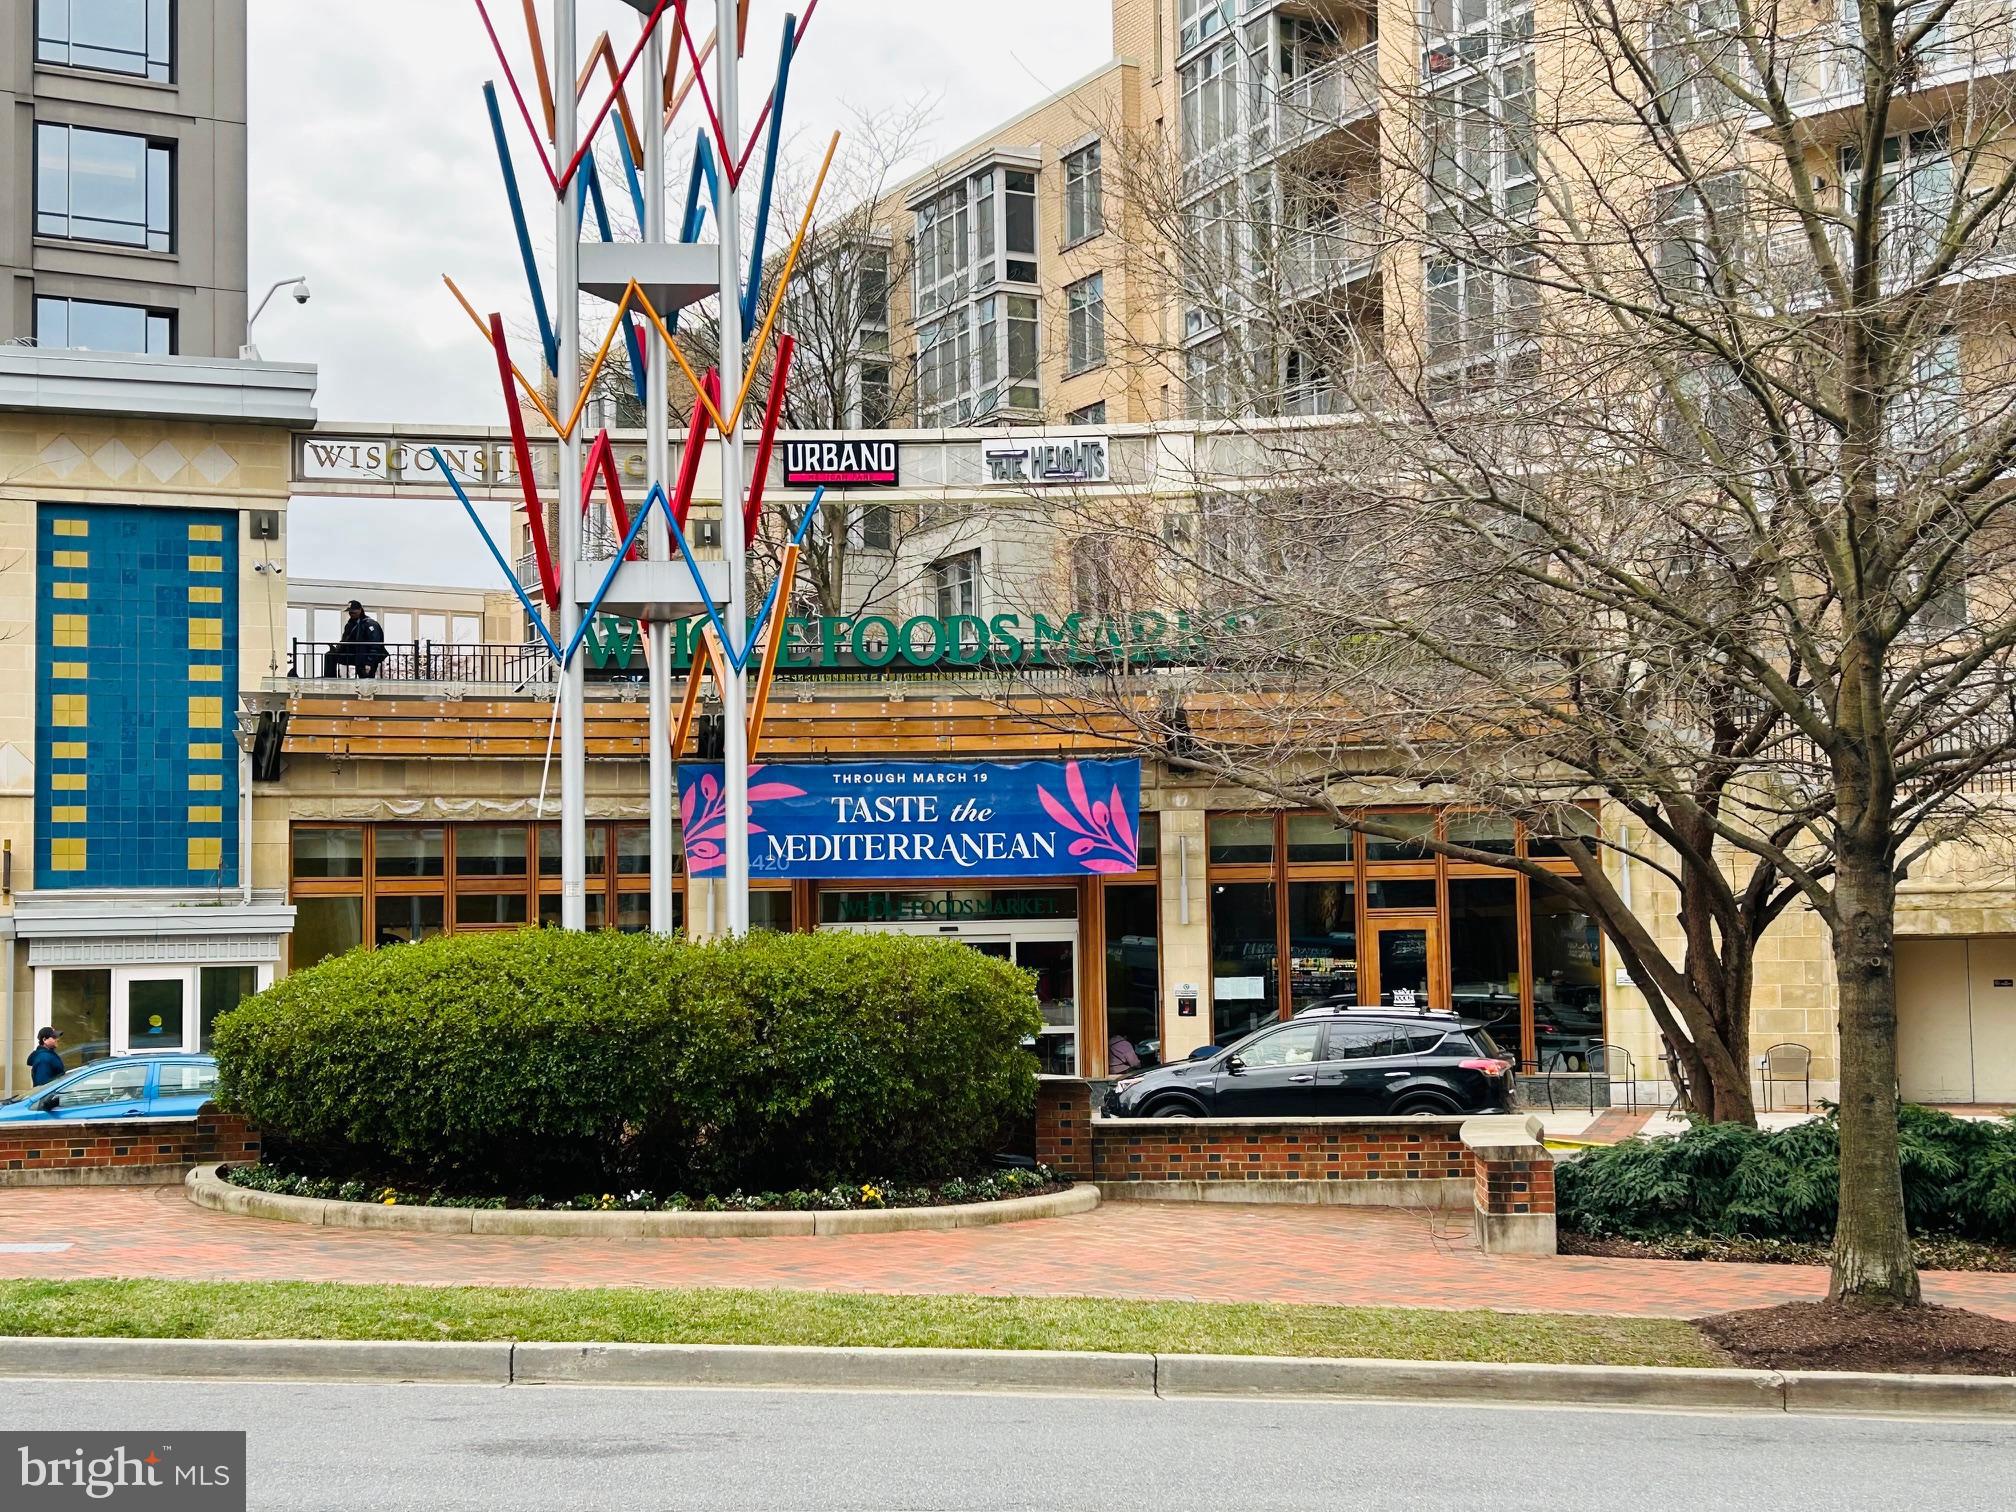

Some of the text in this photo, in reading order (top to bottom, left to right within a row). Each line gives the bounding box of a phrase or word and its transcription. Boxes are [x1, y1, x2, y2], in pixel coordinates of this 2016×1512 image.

[787, 443, 895, 472] URBANO
[986, 439, 1105, 480] THE HEIGHTS
[822, 614, 1023, 667] FOODS
[833, 773, 988, 784] THROUGH MARCH 19
[831, 796, 996, 823] TASTE the
[767, 832, 1056, 867] MEDITERRANEAN
[976, 897, 1058, 915] MARKET
